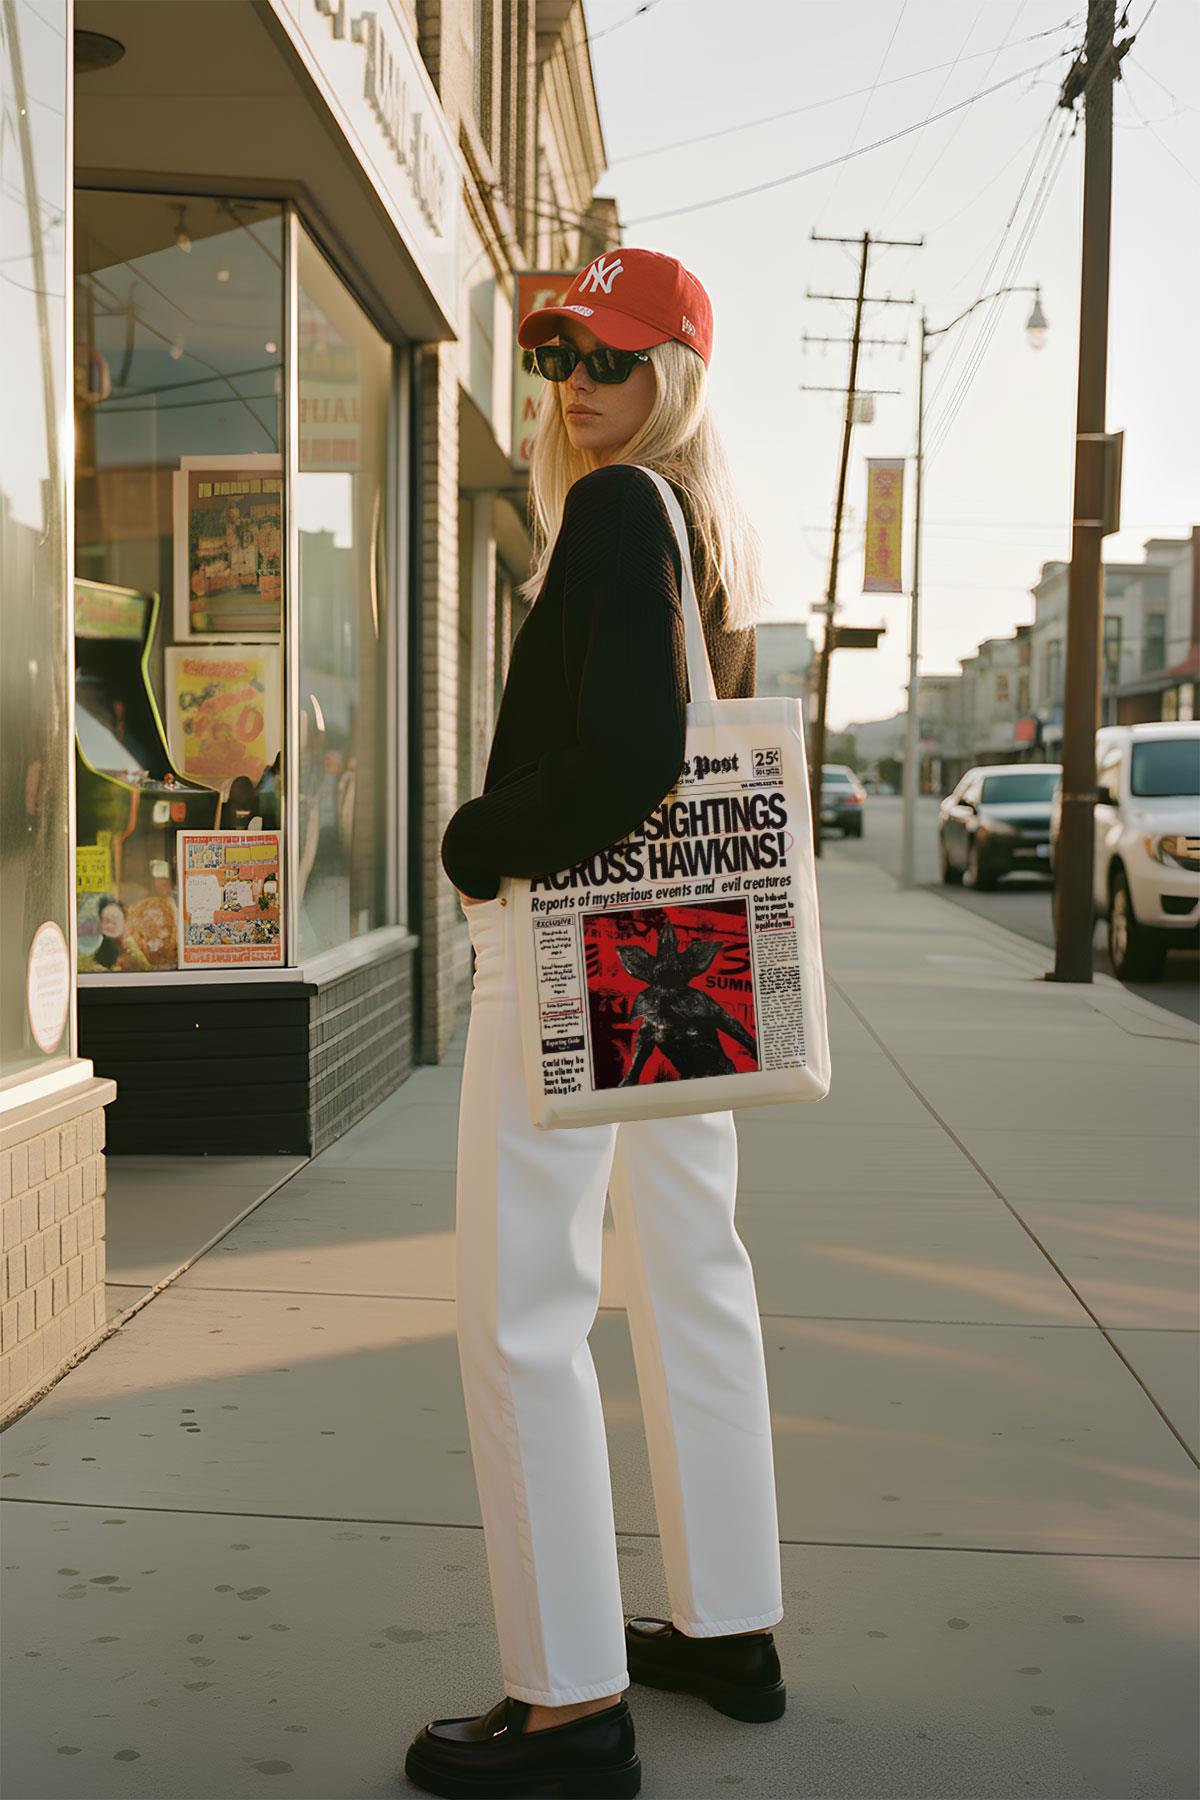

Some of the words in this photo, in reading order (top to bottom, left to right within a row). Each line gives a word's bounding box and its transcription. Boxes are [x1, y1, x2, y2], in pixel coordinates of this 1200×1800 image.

[578, 256, 624, 294] NY
[694, 753, 739, 780] Post
[644, 793, 788, 841] SIGHTINGS
[648, 832, 787, 880] HAWKINS!
[531, 896, 575, 915] Reports
[578, 891, 591, 907] of
[592, 887, 653, 909] mysterious
[656, 884, 692, 900] events
[695, 879, 715, 895] and
[721, 876, 741, 893] evil
[743, 875, 792, 890] creatures
